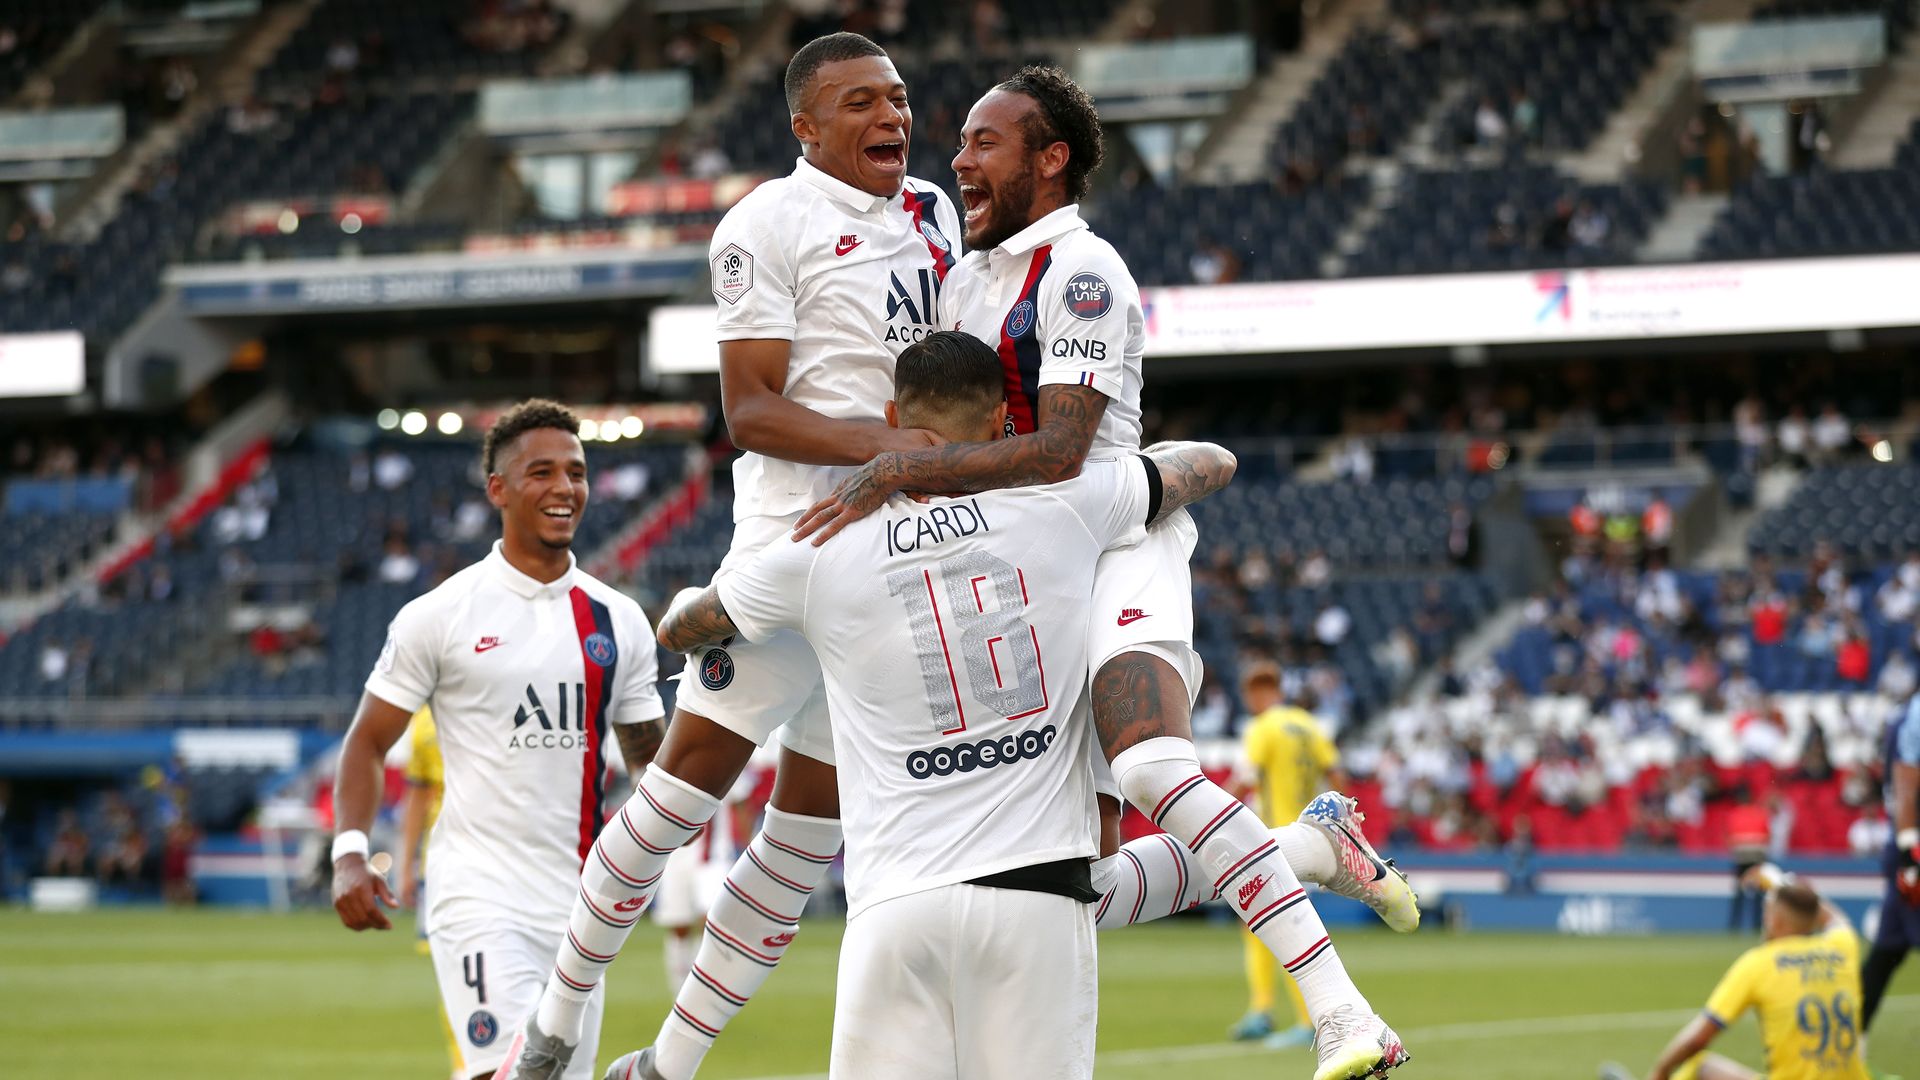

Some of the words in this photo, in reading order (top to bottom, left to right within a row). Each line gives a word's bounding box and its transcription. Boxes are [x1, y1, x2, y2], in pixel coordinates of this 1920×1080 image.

[840, 234, 858, 246] NIKE
[1070, 281, 1106, 293] TOUS
[1074, 291, 1101, 302] UNIS
[884, 324, 935, 343] ACC
[1052, 337, 1107, 361] QNB
[886, 498, 990, 557] ICARDI
[1121, 608, 1145, 619] NIKE
[886, 550, 1049, 736] 18
[711, 652, 730, 668] PARIS
[908, 726, 1057, 776] ooredoo
[1239, 873, 1263, 900] NIKE
[463, 951, 488, 1005] 4
[1797, 991, 1857, 1057] 98
